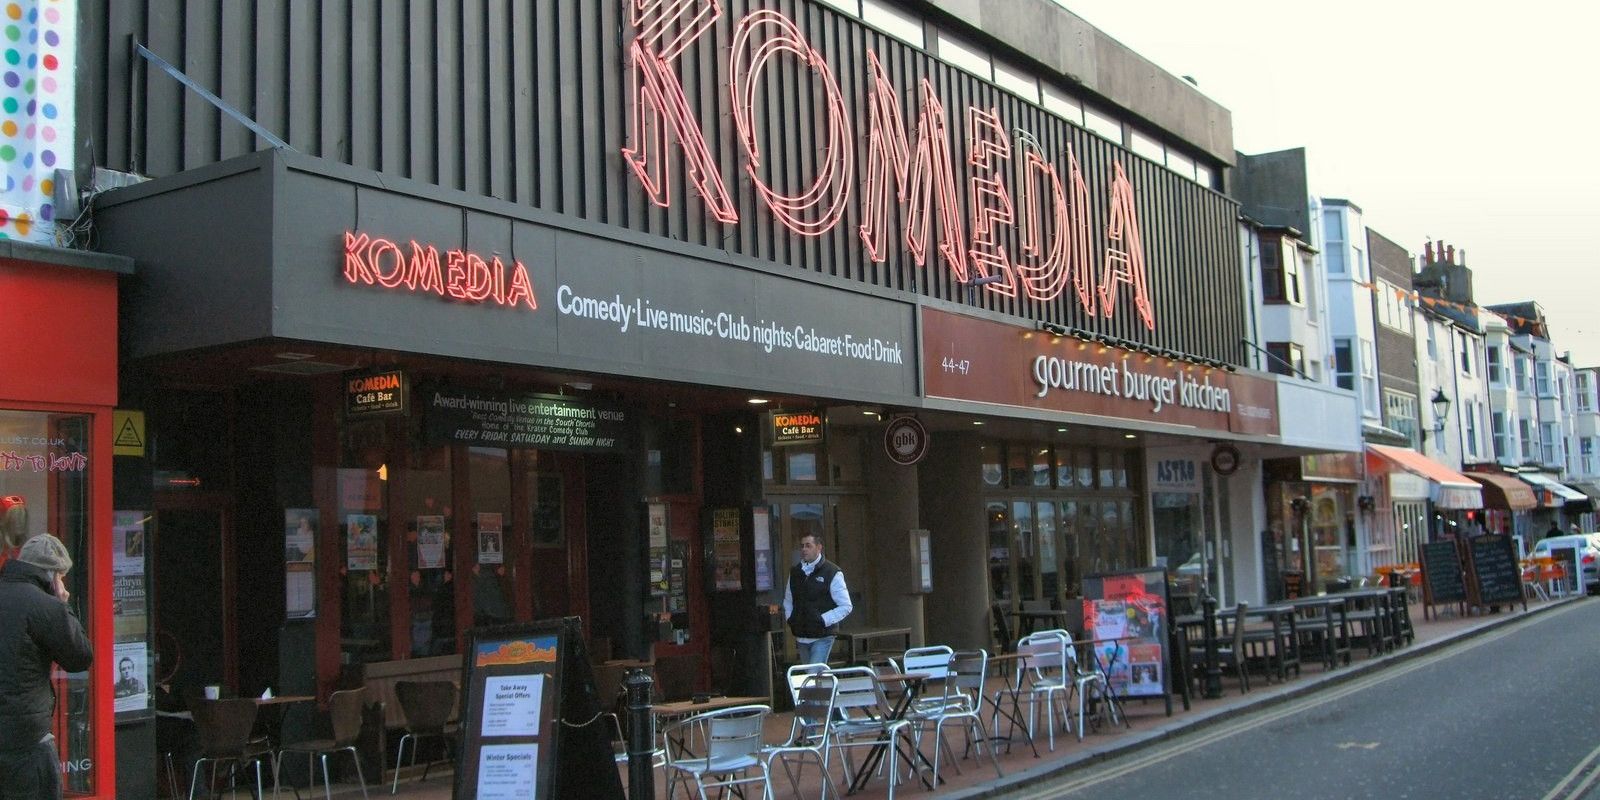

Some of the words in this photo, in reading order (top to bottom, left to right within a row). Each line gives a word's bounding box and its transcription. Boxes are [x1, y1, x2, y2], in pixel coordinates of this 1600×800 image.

[621, 0, 1154, 330] KOMEDIA
[343, 231, 537, 310] KOMEDIA
[717, 312, 750, 341] Club
[942, 356, 970, 375] 44-47
[348, 374, 400, 393] KOMEDIA
[1033, 354, 1120, 398] gourmet
[1123, 359, 1176, 413] burger
[1180, 370, 1231, 413] kitchen
[356, 393, 375, 404] Café
[377, 392, 393, 402] Bar
[433, 392, 508, 416] Award-winning
[509, 398, 527, 413] live
[528, 402, 597, 419] entertainment
[597, 410, 625, 421] venue
[775, 415, 821, 427] KOMEDIA
[782, 426, 799, 435] Café
[801, 425, 815, 434] Bar
[455, 429, 479, 440] EVERY
[510, 432, 551, 445] SATURDAY
[552, 435, 567, 445] and
[568, 436, 595, 447] SUNDAY
[595, 437, 615, 448] NIGHT
[549, 425, 574, 437] Comedy
[575, 427, 588, 436] Club
[895, 432, 915, 449] gbk
[513, 684, 528, 692] Away
[60, 758, 92, 774] ING
[486, 753, 505, 761] Winter
[506, 753, 532, 762] Specials
